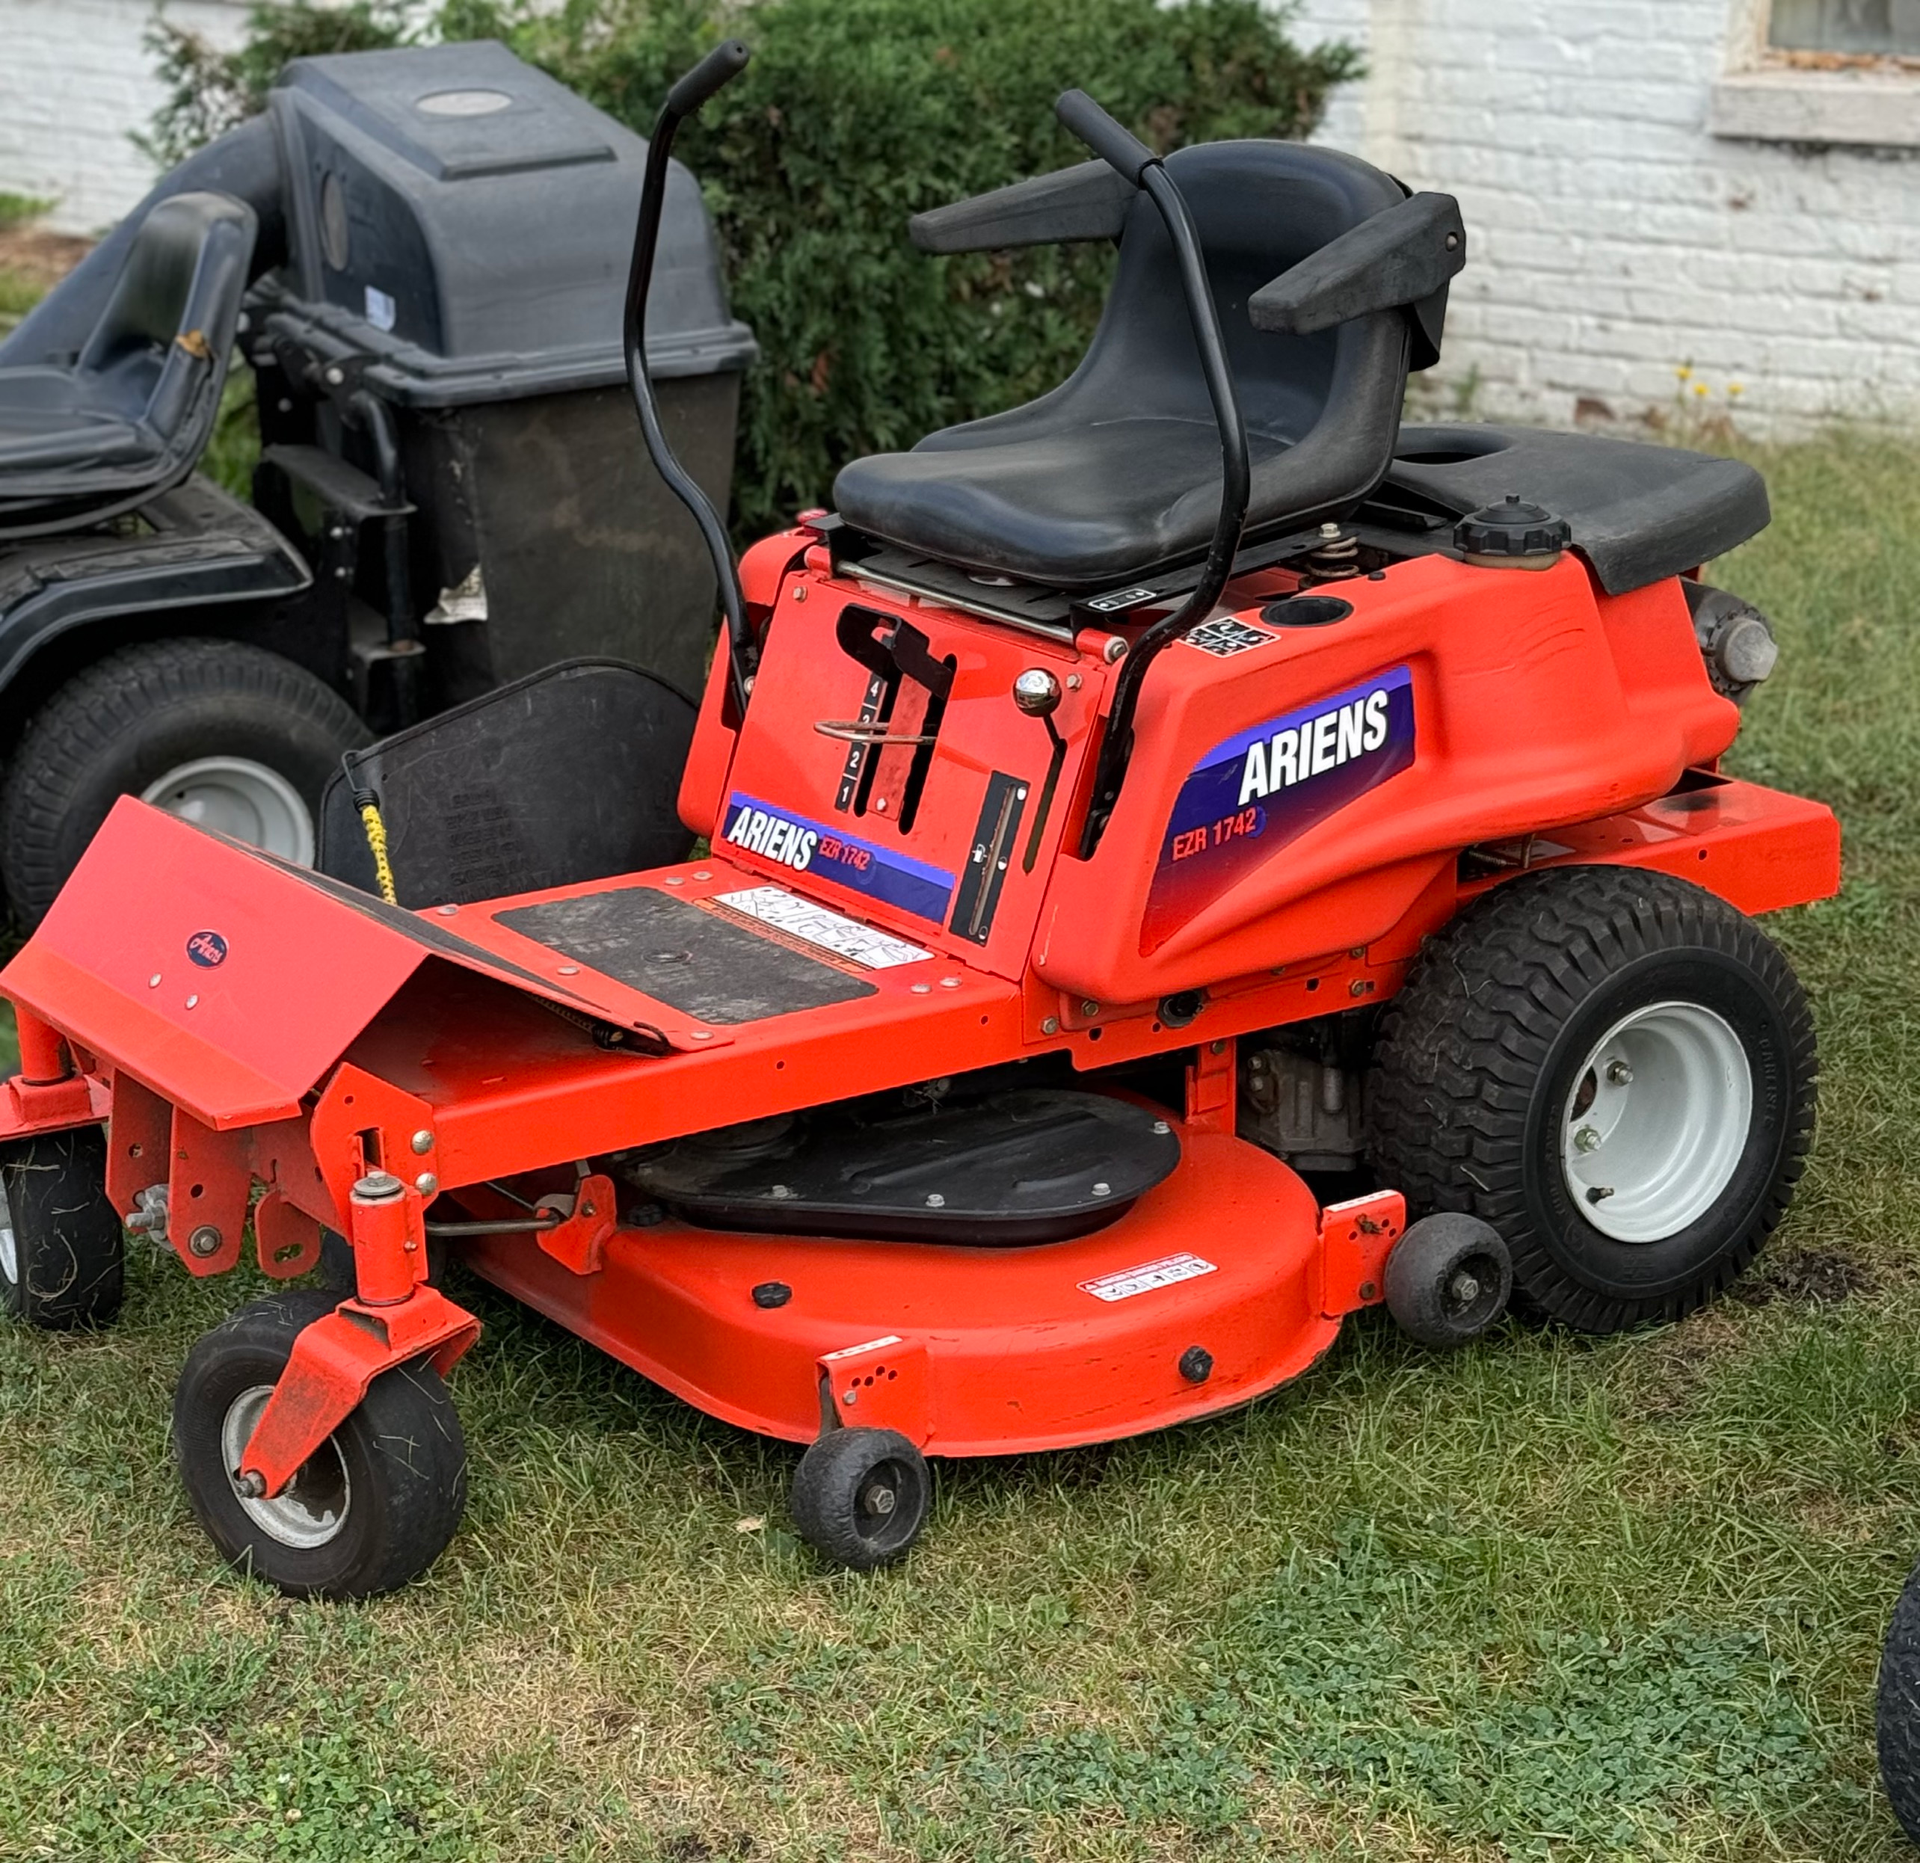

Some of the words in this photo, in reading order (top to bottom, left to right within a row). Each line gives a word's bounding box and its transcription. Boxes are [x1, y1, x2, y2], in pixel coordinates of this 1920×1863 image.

[870, 680, 880, 698] 4
[849, 750, 861, 769] 2
[1237, 688, 1389, 806] ARIENS
[841, 785, 850, 803] 1
[727, 805, 819, 871] ARIENS
[818, 836, 843, 861] EZR
[841, 845, 872, 872] 1742
[1172, 826, 1207, 861] EZR
[1212, 806, 1257, 846] 1742
